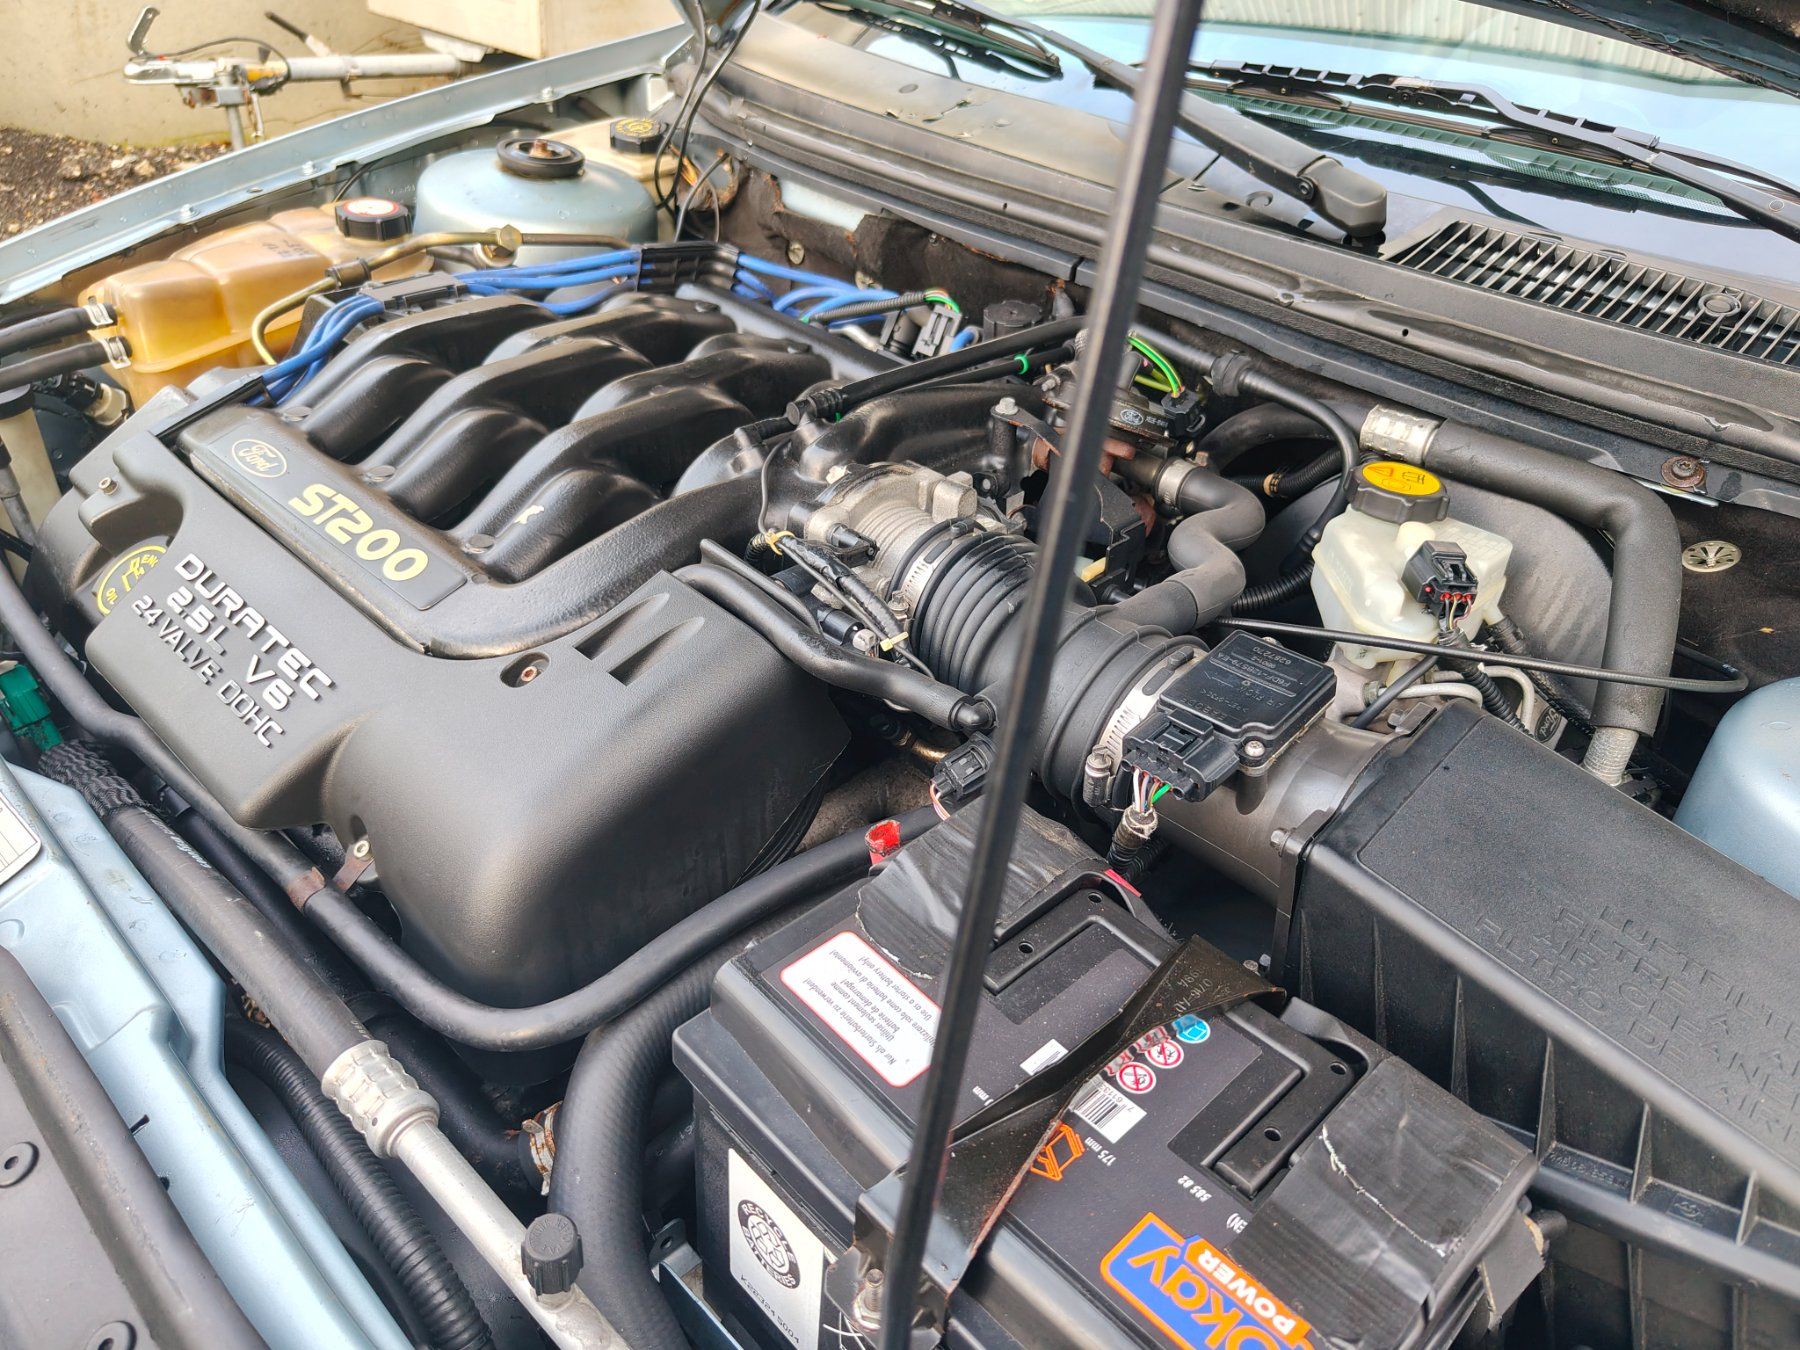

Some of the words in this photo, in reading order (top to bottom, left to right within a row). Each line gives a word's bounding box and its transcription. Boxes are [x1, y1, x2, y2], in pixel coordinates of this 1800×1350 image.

[236, 441, 282, 473] Ford
[288, 483, 428, 581] ST200
[105, 586, 117, 604] OIL
[174, 553, 334, 700] DURATEC
[131, 595, 163, 627] 24
[159, 617, 222, 684] VALVE
[216, 679, 284, 748] DOHC
[244, 654, 295, 710] V6
[1538, 707, 1560, 739] Ford
[1557, 907, 1691, 1006] FILTRE
[1474, 915, 1605, 1013] FILTRO
[1628, 1020, 1685, 1074] DE
[911, 1022, 936, 1047] tilizzare
[1618, 981, 1800, 1110] CLEANE
[1084, 1136, 1102, 1153] mm
[1097, 1150, 1117, 1167] 175
[741, 1204, 797, 1263] RECYCLE
[1198, 1249, 1297, 1336] POWER
